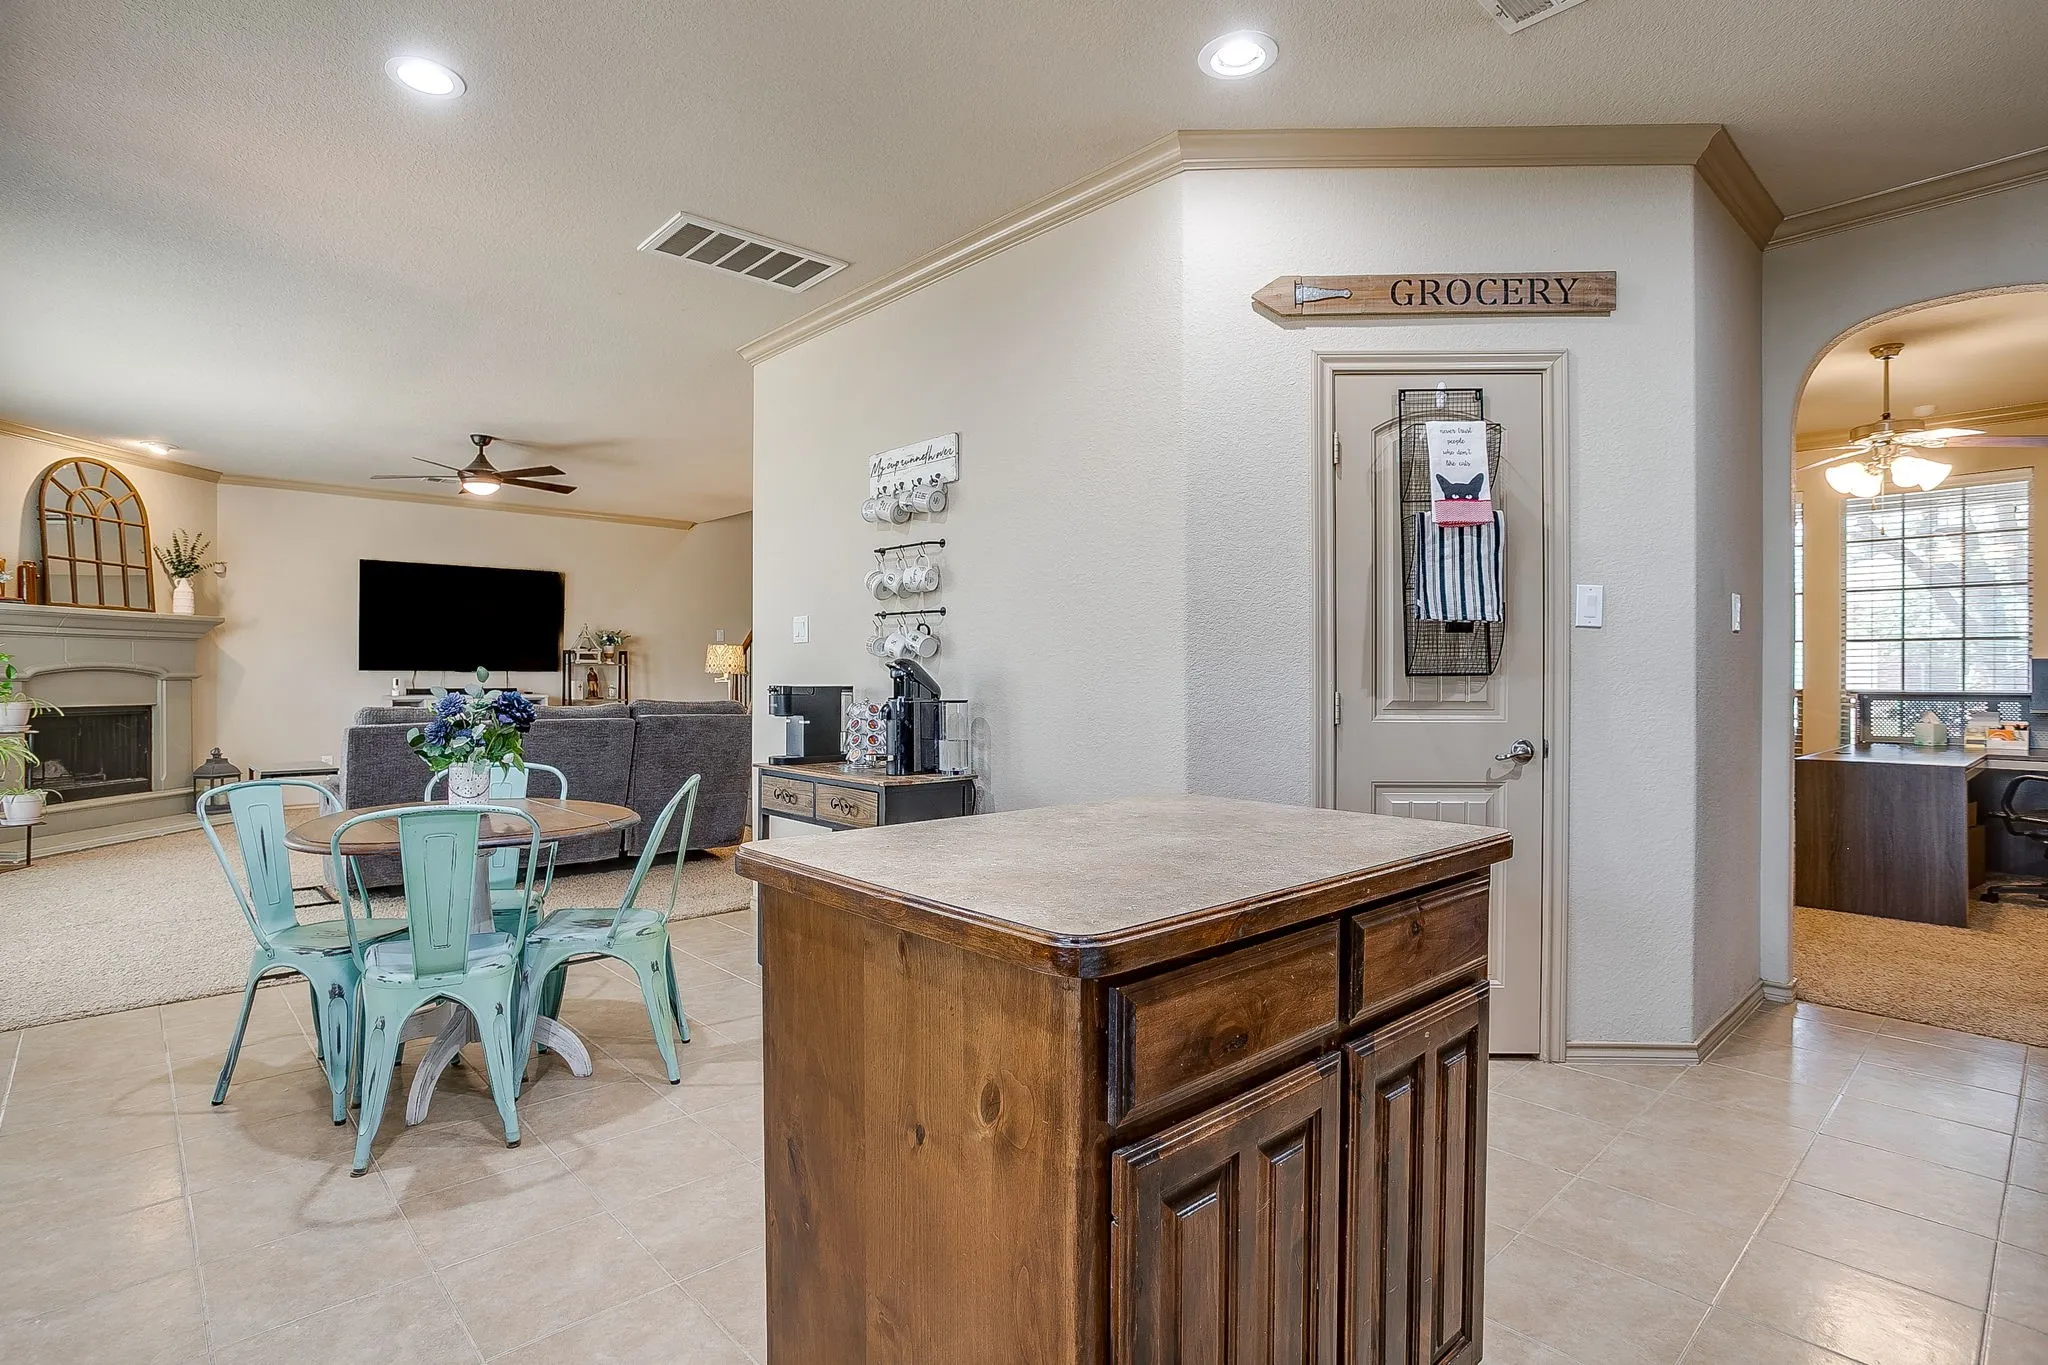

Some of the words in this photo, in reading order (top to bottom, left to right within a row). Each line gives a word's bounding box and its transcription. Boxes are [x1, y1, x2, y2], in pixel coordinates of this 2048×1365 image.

[1391, 278, 1579, 306] GROCERY
[1447, 437, 1465, 445] people
[870, 458, 886, 482] My
[887, 460, 900, 476] cup
[936, 447, 954, 459] over
